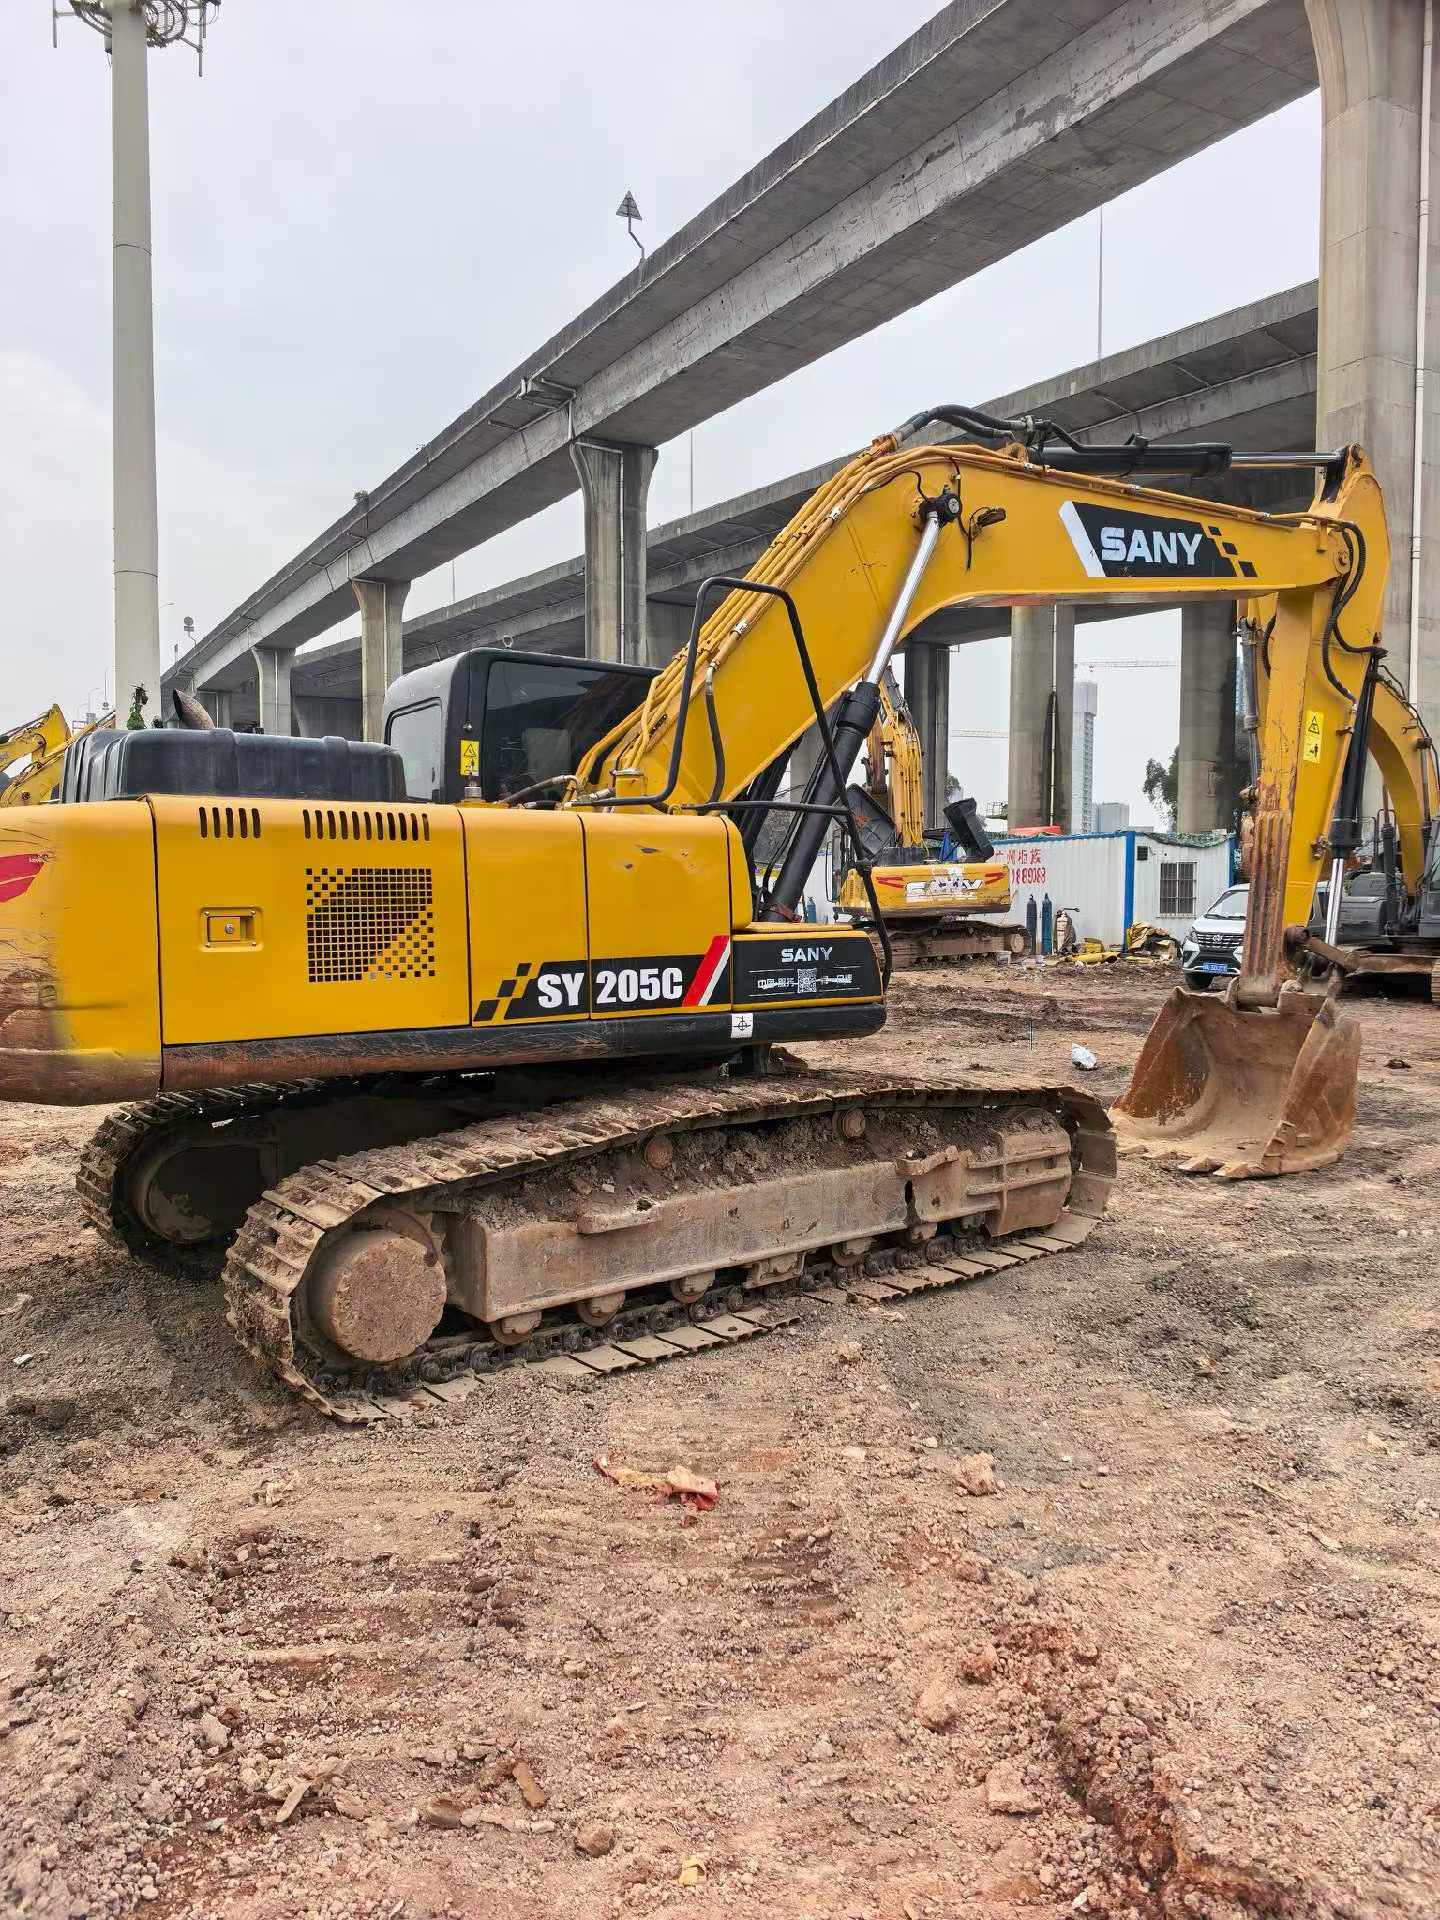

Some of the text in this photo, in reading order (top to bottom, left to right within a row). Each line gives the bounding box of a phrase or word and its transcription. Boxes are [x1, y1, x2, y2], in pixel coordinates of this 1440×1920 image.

[1101, 526, 1203, 566] SANY
[781, 946, 833, 963] SANY
[537, 967, 683, 1009] SY 205C
